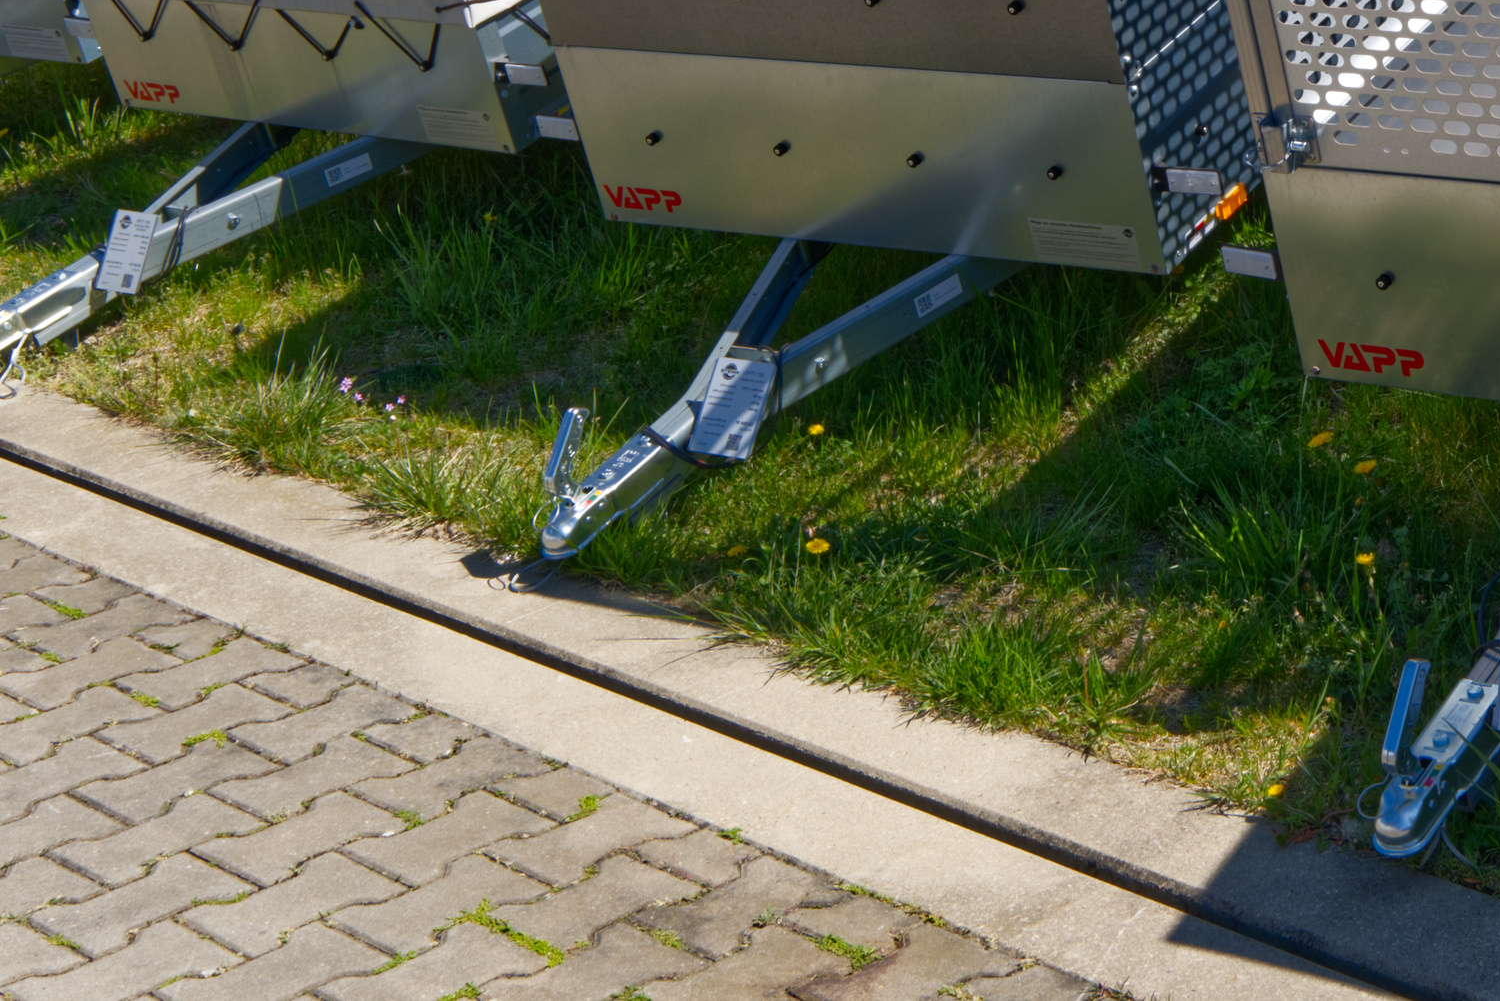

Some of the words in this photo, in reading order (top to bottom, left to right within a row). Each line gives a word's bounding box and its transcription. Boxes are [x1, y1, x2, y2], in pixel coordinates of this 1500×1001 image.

[124, 81, 180, 104] VAPP
[603, 184, 682, 213] VAPP
[1317, 339, 1425, 377] VAPP
